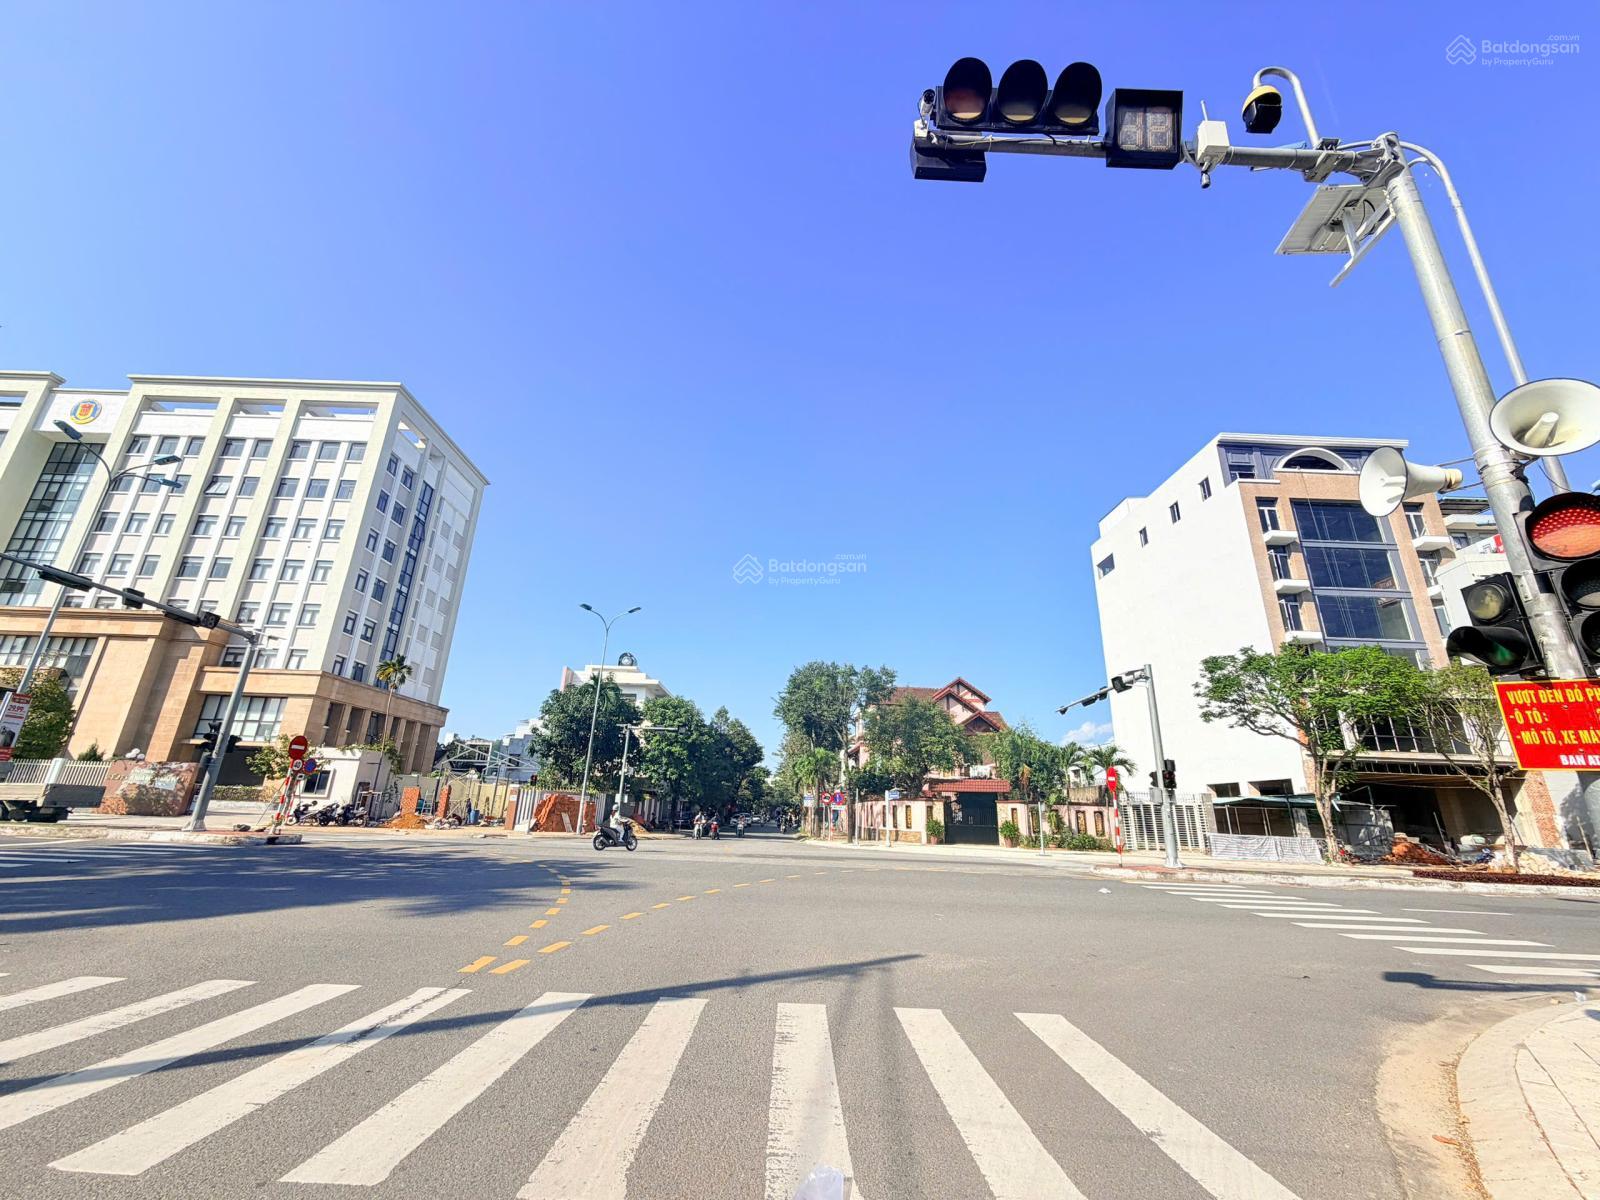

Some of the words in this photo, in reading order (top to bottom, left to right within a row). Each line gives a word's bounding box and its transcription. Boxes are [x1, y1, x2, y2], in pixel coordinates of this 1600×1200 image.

[1505, 688, 1537, 706] VƯỢT
[1560, 730, 1578, 745] XE
[1560, 754, 1587, 766] BAN
